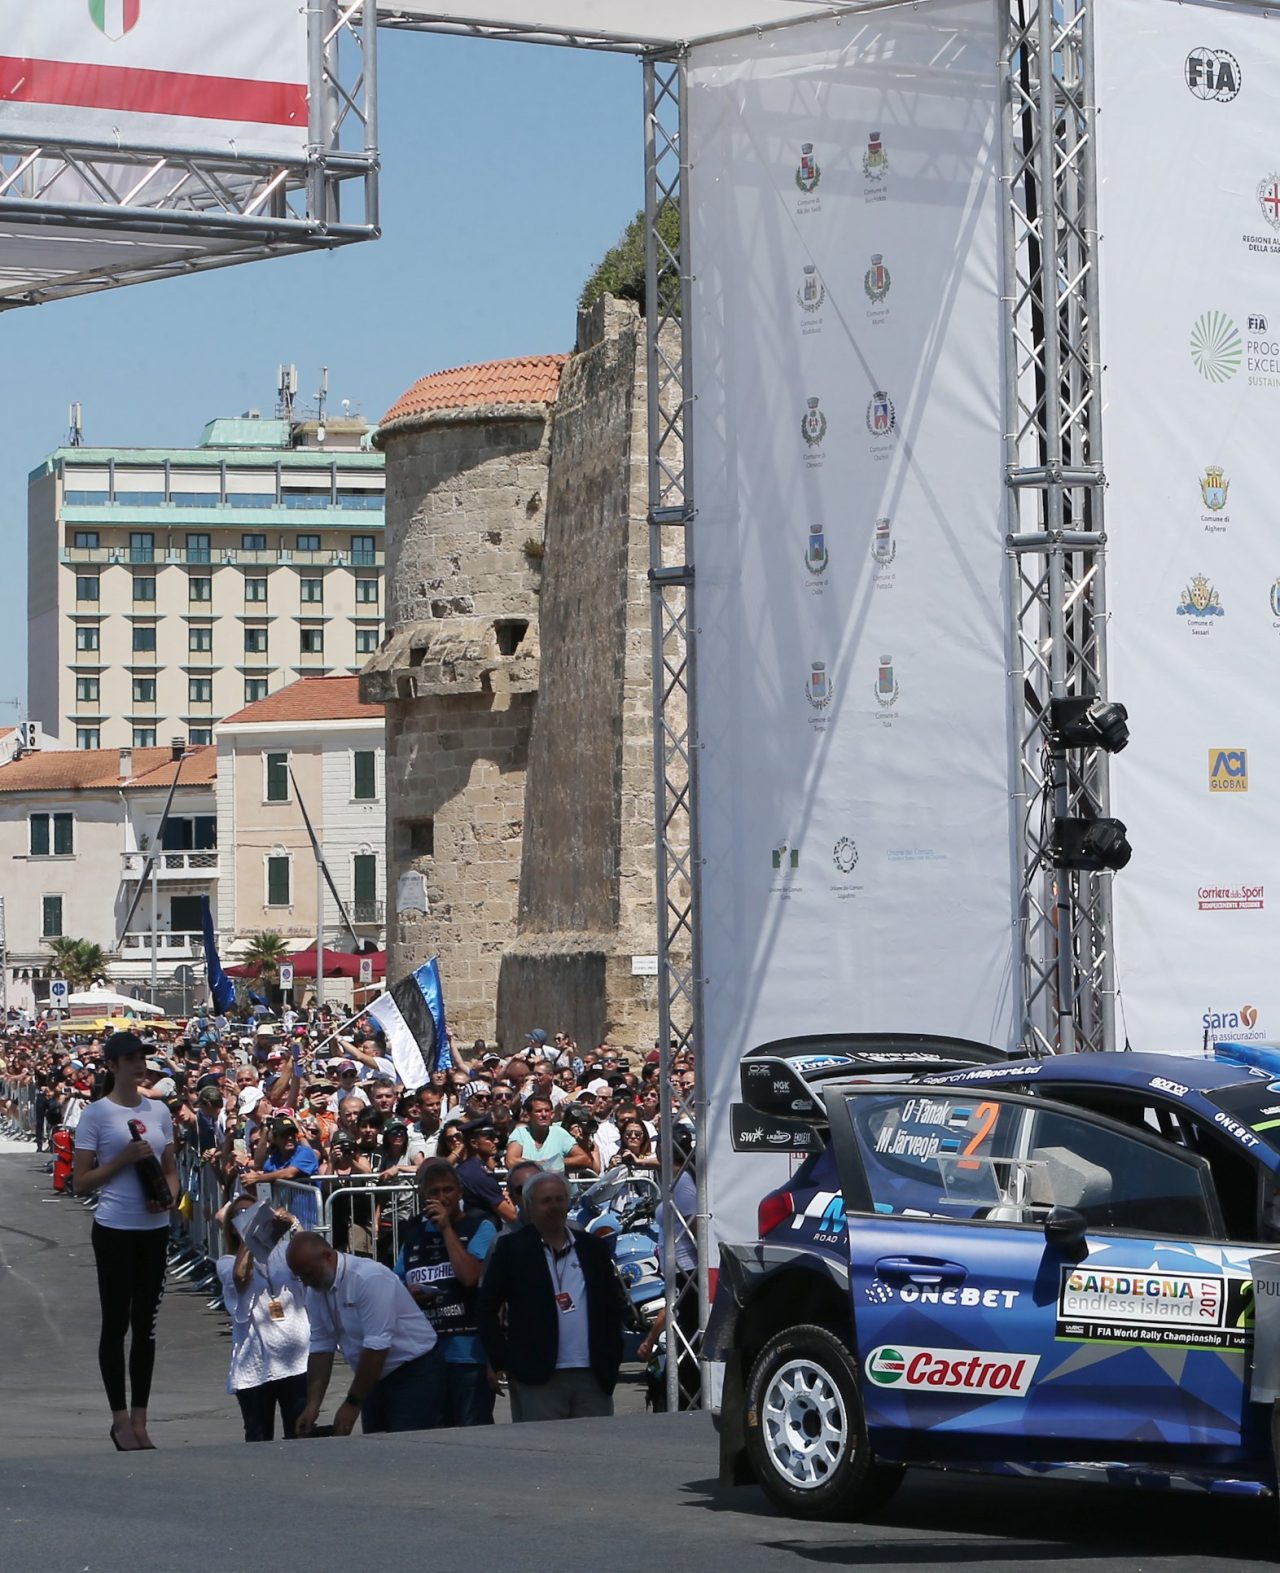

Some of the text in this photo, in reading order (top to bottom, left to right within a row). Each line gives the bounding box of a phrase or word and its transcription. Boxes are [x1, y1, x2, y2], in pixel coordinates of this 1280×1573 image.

[1242, 235, 1272, 245] REGIONE
[1248, 244, 1268, 253] DELLA
[1201, 515, 1222, 523] Comune
[1204, 525, 1226, 533] Alghero
[1211, 780, 1246, 790] GLOBAL
[1198, 887, 1230, 899] Corriere
[1242, 886, 1264, 900] Sport
[1202, 1012, 1238, 1029] sara
[1202, 1030, 1266, 1042] sara assicurazioni
[749, 1064, 770, 1072] OZ
[773, 1081, 790, 1090] NGK
[923, 1072, 967, 1085] Search
[1150, 1076, 1188, 1094] sparco
[916, 1098, 950, 1125] Tänak
[740, 1132, 760, 1142] SWP
[957, 1102, 1000, 1170] 2
[1214, 1112, 1260, 1148] ONEBET
[876, 1127, 940, 1163] M Järveoja
[813, 1234, 838, 1243] ROAD
[1069, 1274, 1194, 1299] SARDEGNA
[900, 1284, 1020, 1308] ONEBET
[1200, 1283, 1217, 1318] 2017
[1067, 1296, 1194, 1317] endless island
[1066, 1325, 1084, 1333] WRC
[1097, 1327, 1112, 1337] FIA
[1113, 1328, 1138, 1338] World
[1140, 1330, 1162, 1341] Rally
[1164, 1331, 1222, 1345] Championship
[906, 1352, 1026, 1390] Castrol
